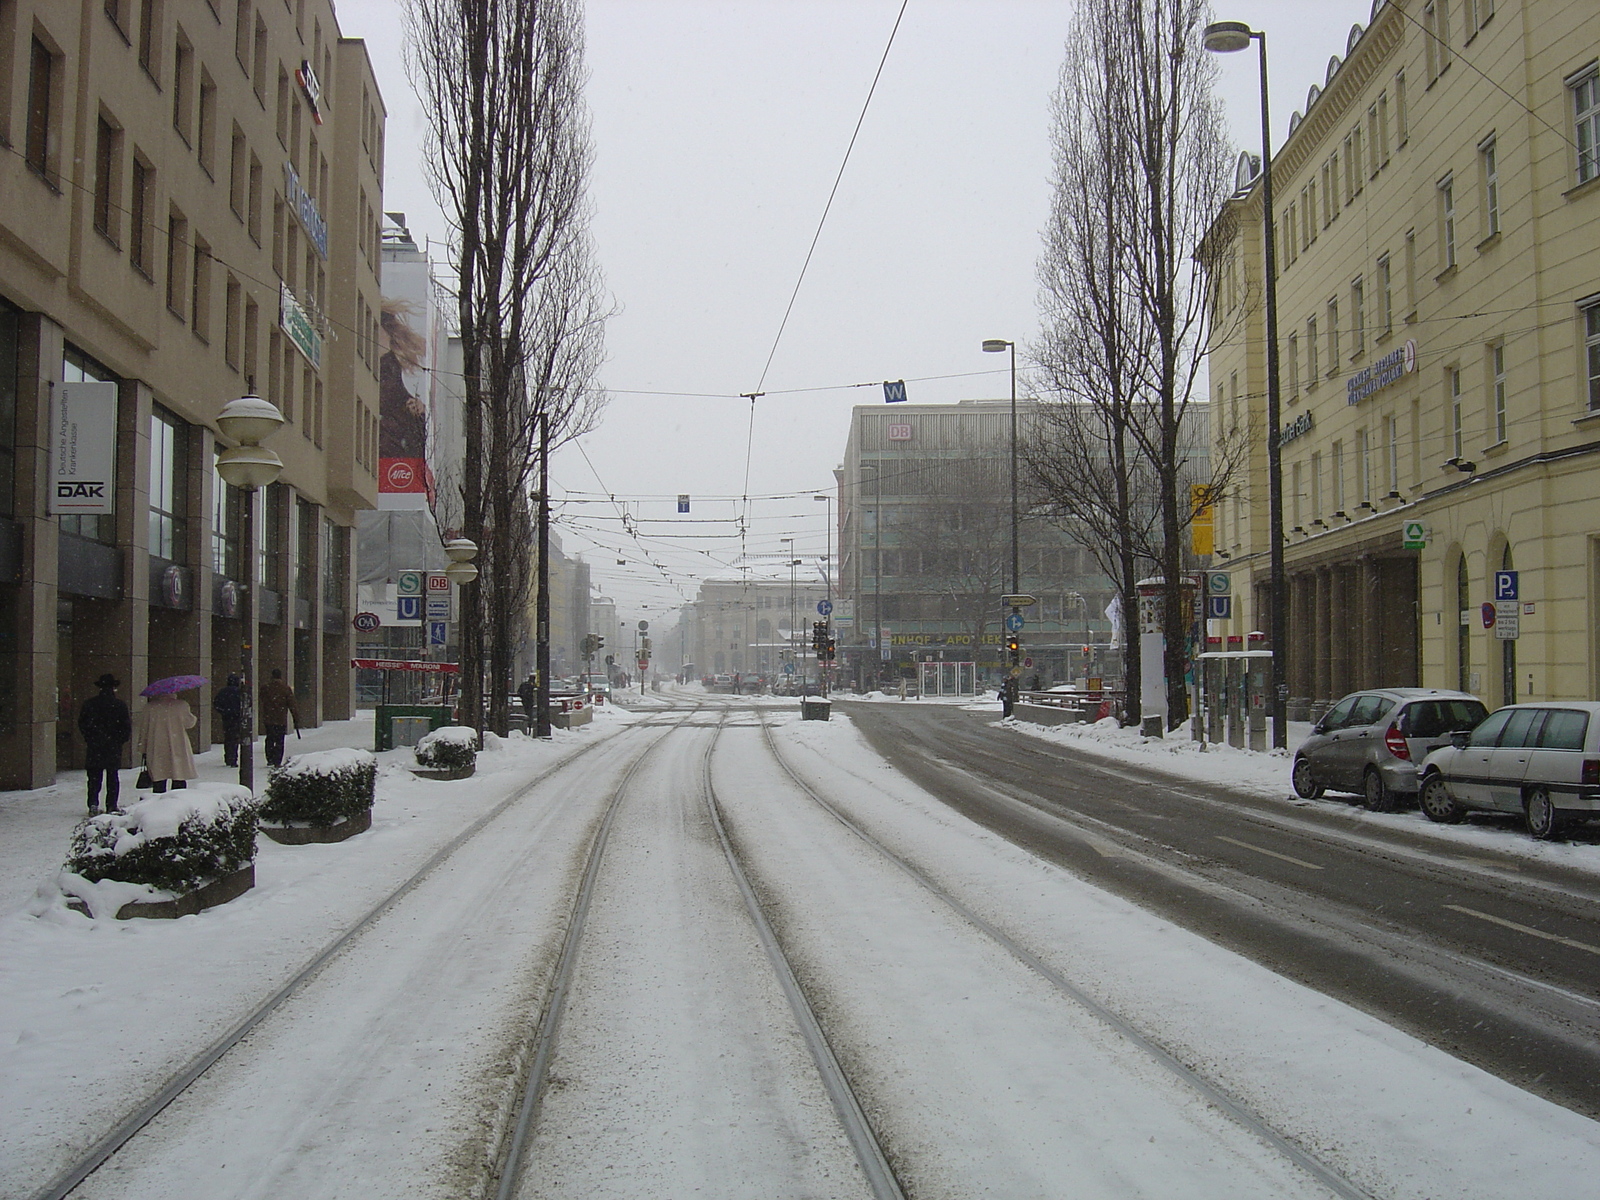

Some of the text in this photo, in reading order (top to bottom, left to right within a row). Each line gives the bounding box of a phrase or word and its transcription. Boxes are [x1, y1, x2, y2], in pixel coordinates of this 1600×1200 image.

[885, 385, 904, 400] W
[890, 426, 909, 438] DB
[58, 437, 67, 476] Deutsche
[68, 422, 78, 476] Krankenkasse
[57, 482, 104, 498] DAK
[401, 573, 418, 592] S
[431, 578, 447, 588] DB
[1211, 573, 1229, 592] S
[1499, 574, 1512, 597] P
[401, 599, 417, 617] U
[1212, 599, 1228, 617] U
[358, 617, 375, 627] C&A
[890, 635, 931, 645] HNHOF
